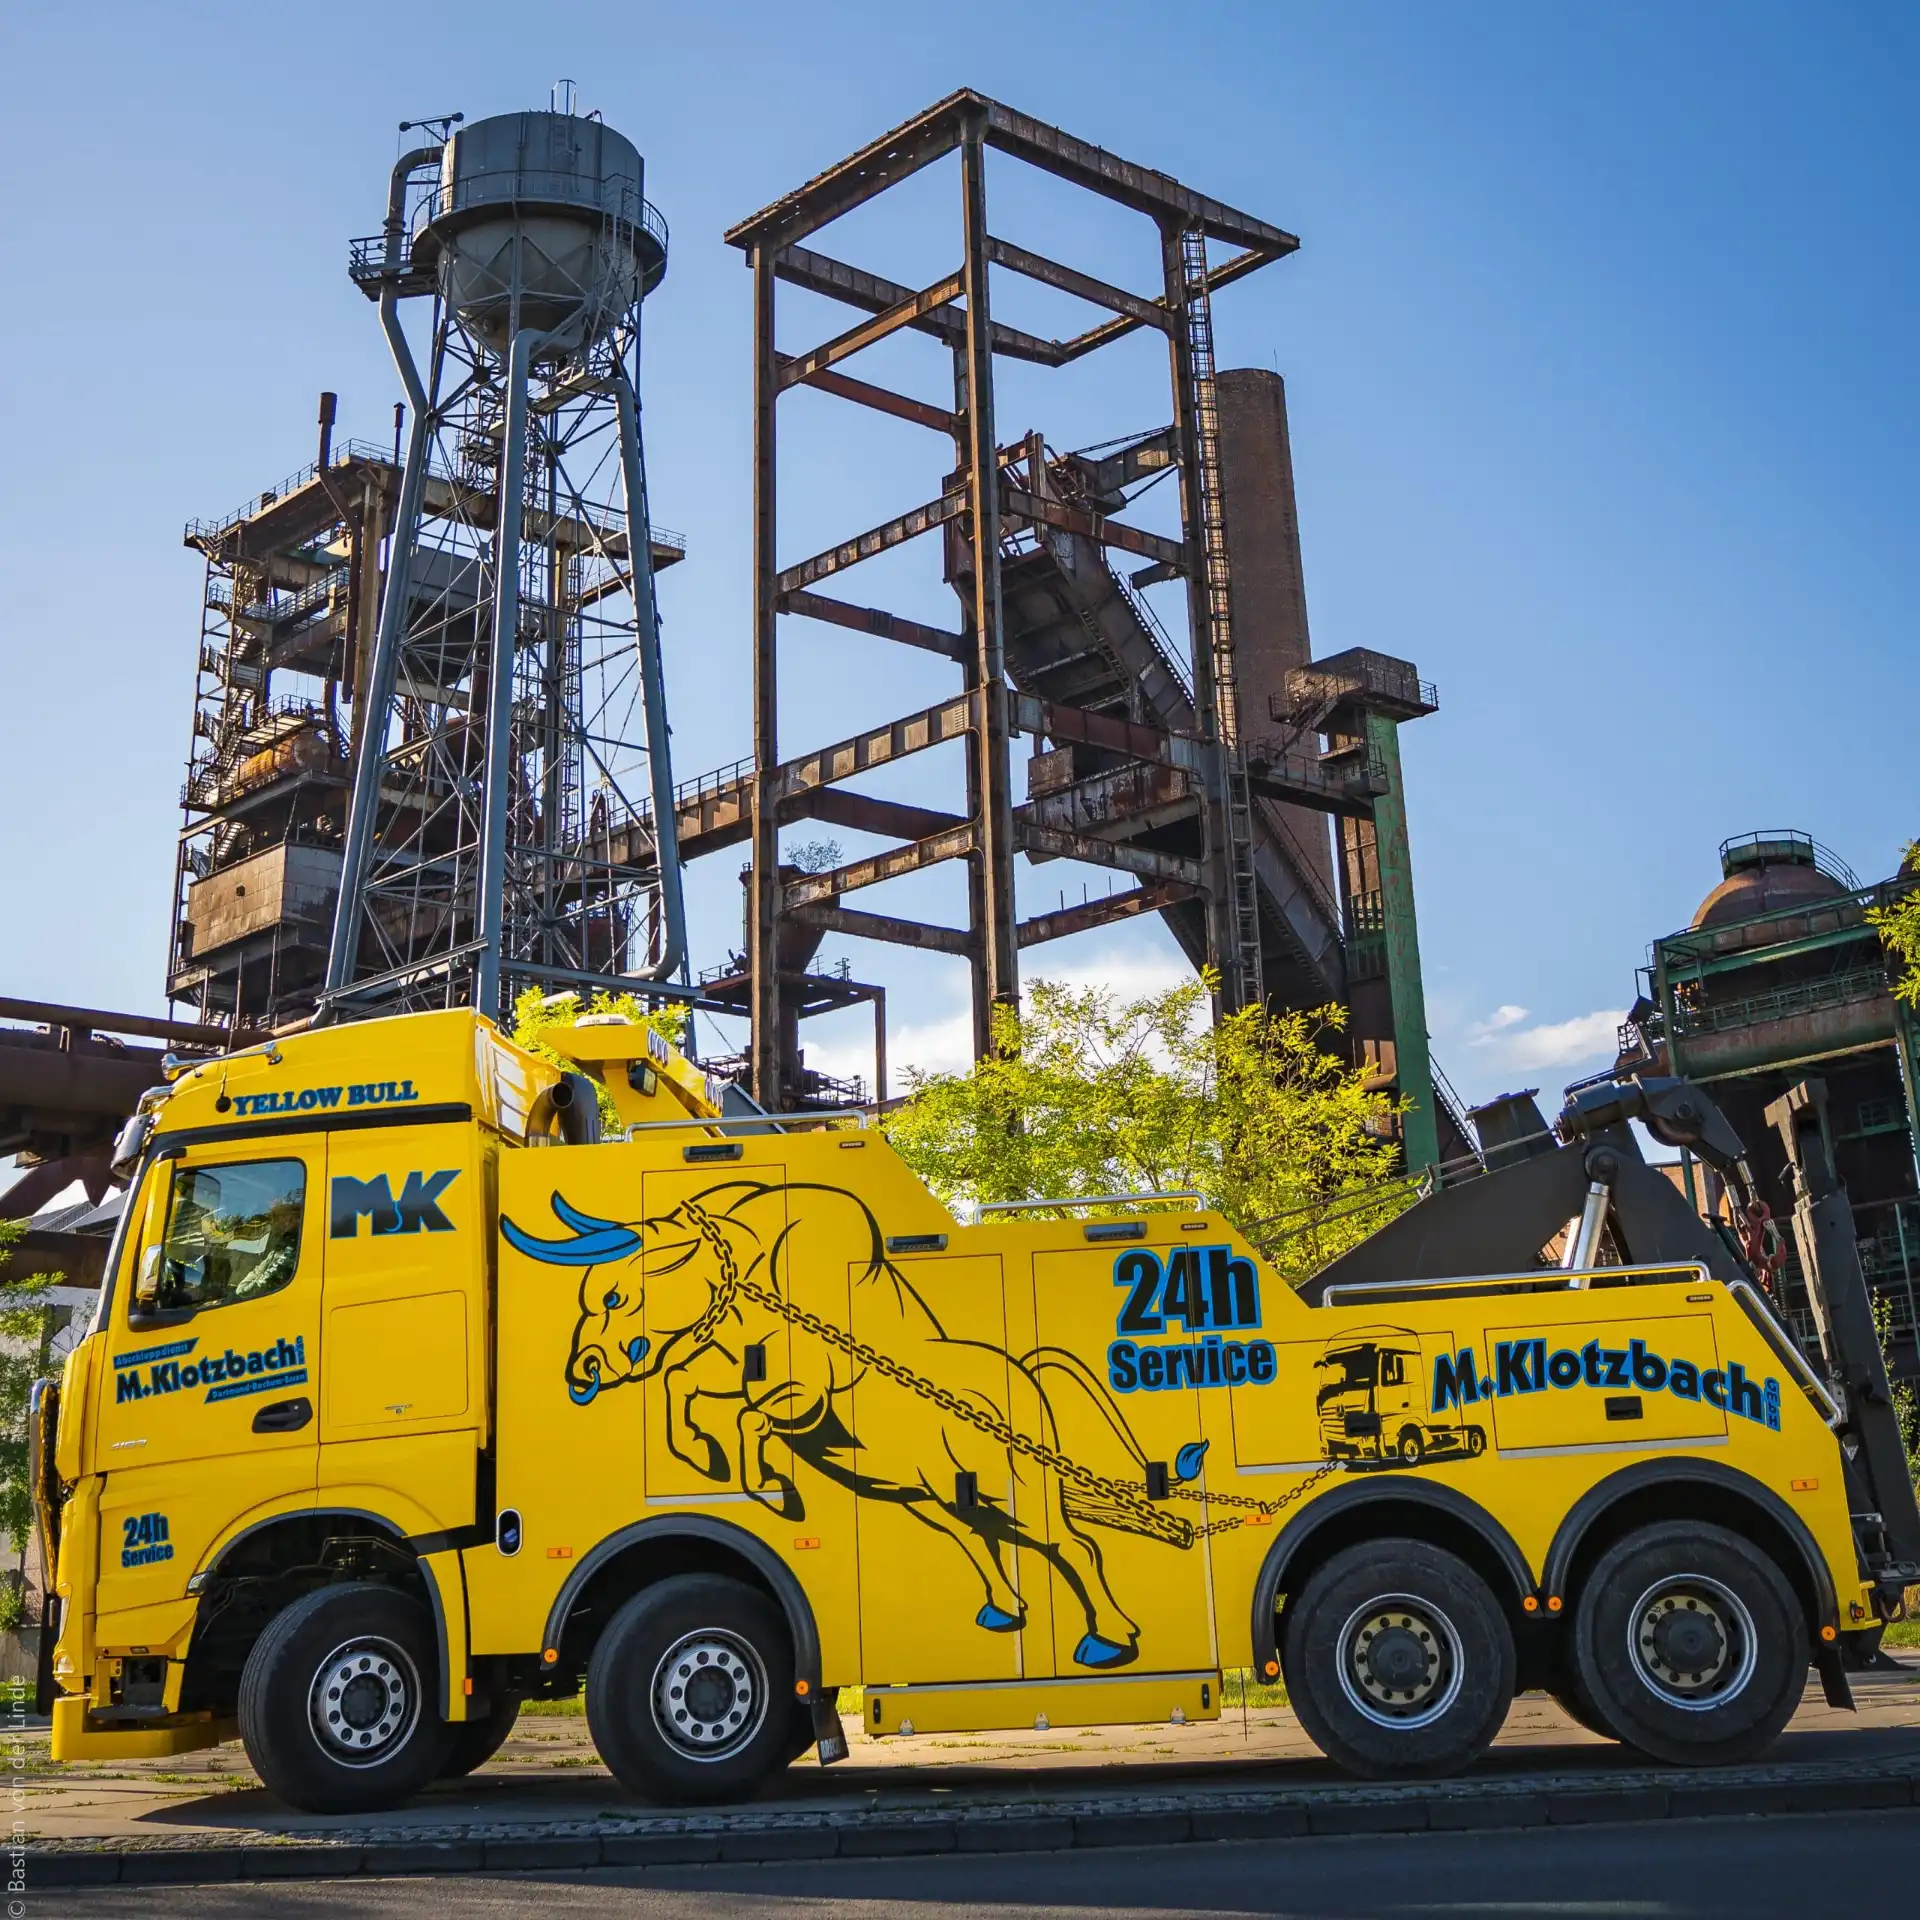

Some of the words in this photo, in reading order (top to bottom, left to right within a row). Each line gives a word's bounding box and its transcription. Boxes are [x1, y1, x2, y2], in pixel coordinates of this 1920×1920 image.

[232, 1086, 343, 1116] YELLOW
[347, 1080, 419, 1105] BULL
[330, 1168, 462, 1240] MK
[1113, 1244, 1262, 1337] 24h
[1107, 1334, 1277, 1393] Service
[123, 1512, 169, 1549] 24h
[121, 1544, 174, 1568] Service
